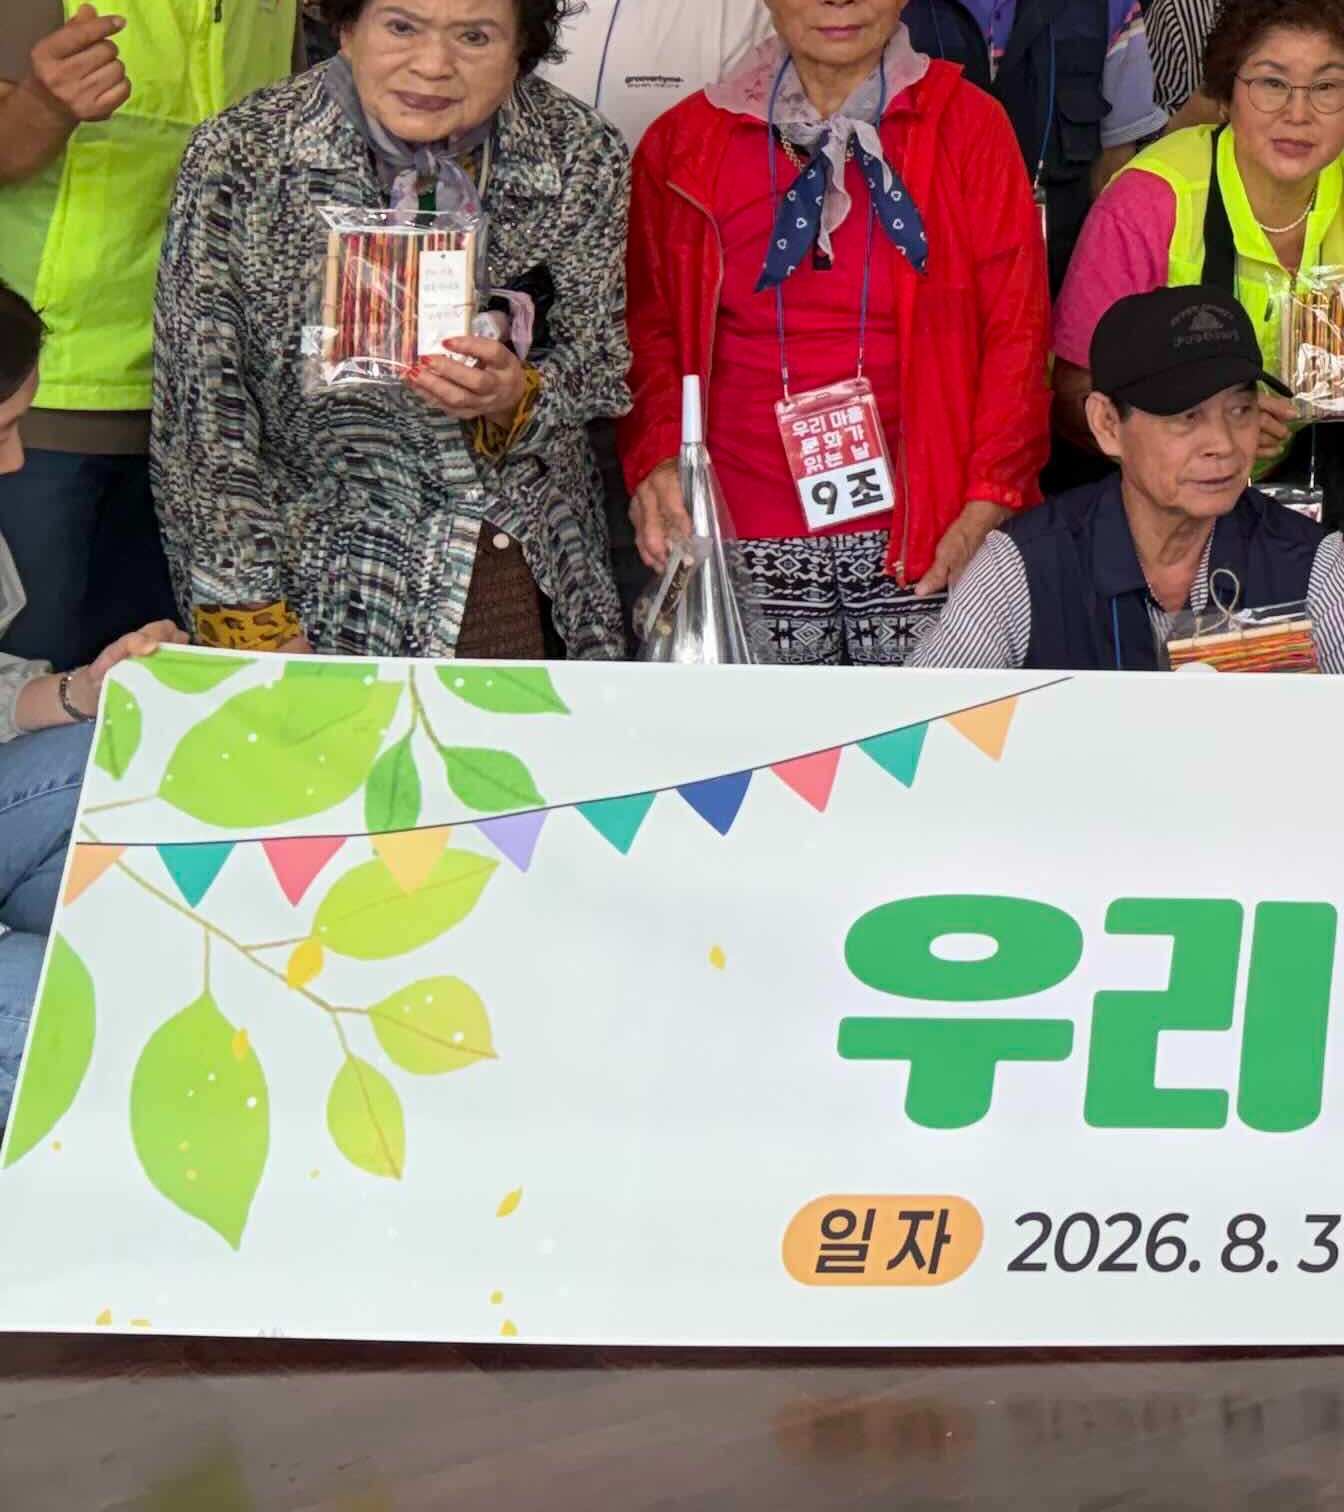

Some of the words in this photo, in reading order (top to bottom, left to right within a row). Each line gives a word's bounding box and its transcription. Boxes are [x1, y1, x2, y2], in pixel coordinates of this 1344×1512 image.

[792, 414, 827, 438] 우리
[837, 894, 1338, 1133] 우리
[815, 1209, 952, 1275] 일자
[1008, 1212, 1200, 1272] 2026.
[1221, 1213, 1278, 1273] 8.
